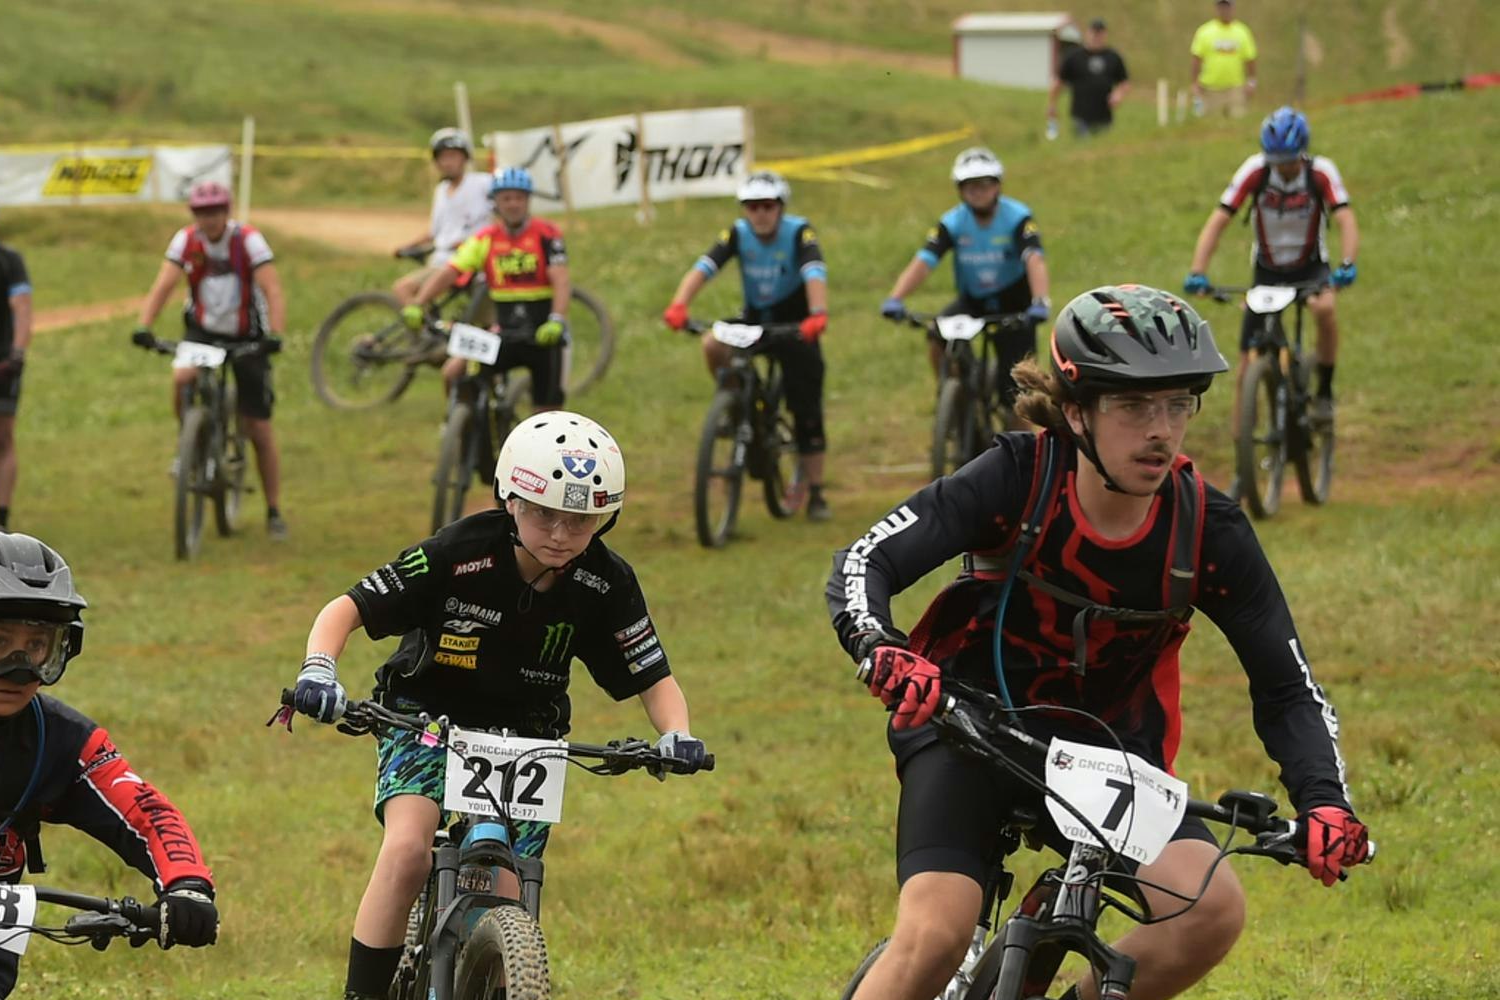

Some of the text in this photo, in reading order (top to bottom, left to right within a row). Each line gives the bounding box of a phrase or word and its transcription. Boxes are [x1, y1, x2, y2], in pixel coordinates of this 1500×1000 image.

[642, 143, 744, 181] THOR
[457, 601, 503, 624] YAMAHA
[462, 755, 548, 807] 212
[1101, 777, 1135, 832] 7
